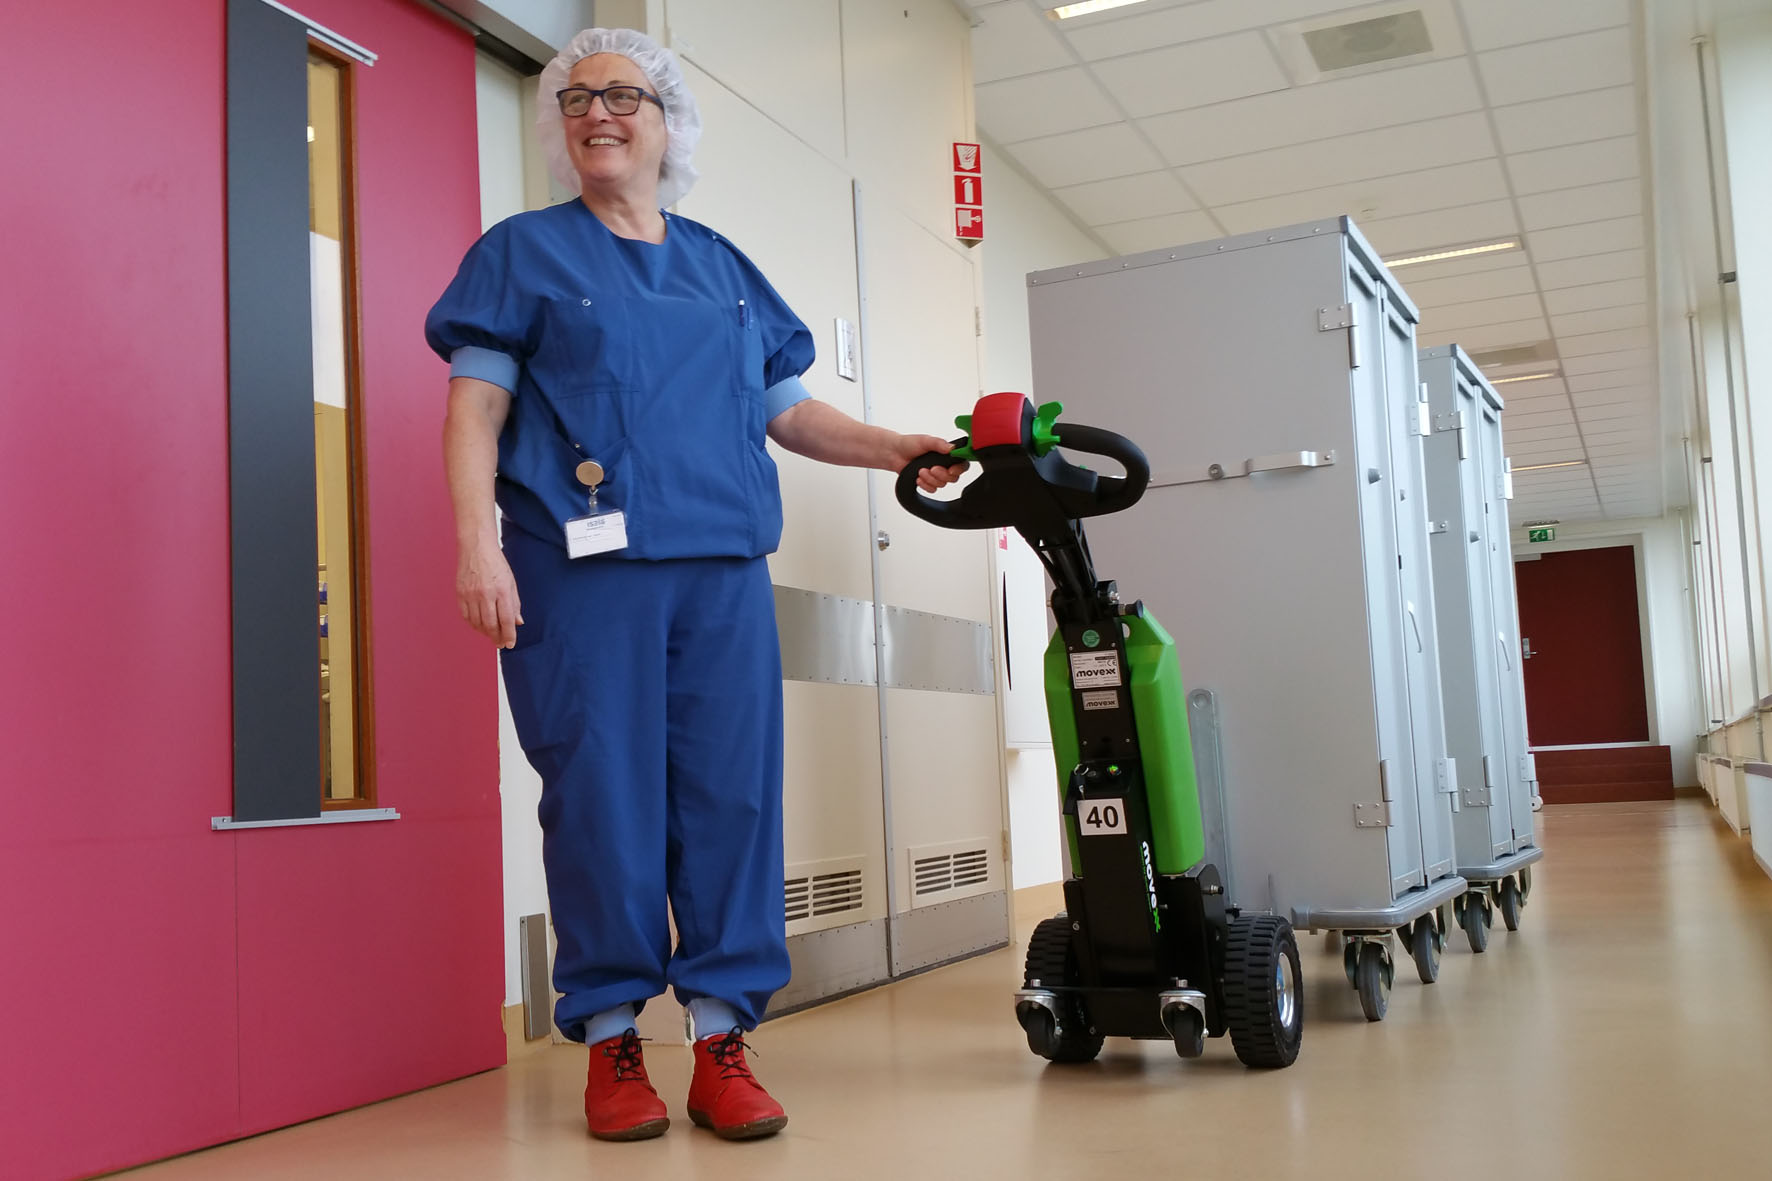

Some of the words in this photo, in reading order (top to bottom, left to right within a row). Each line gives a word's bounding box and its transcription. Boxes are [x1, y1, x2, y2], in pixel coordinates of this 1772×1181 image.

[1076, 668, 1116, 677] movexx
[1086, 805, 1119, 828] 40
[1142, 841, 1161, 933] movexx
